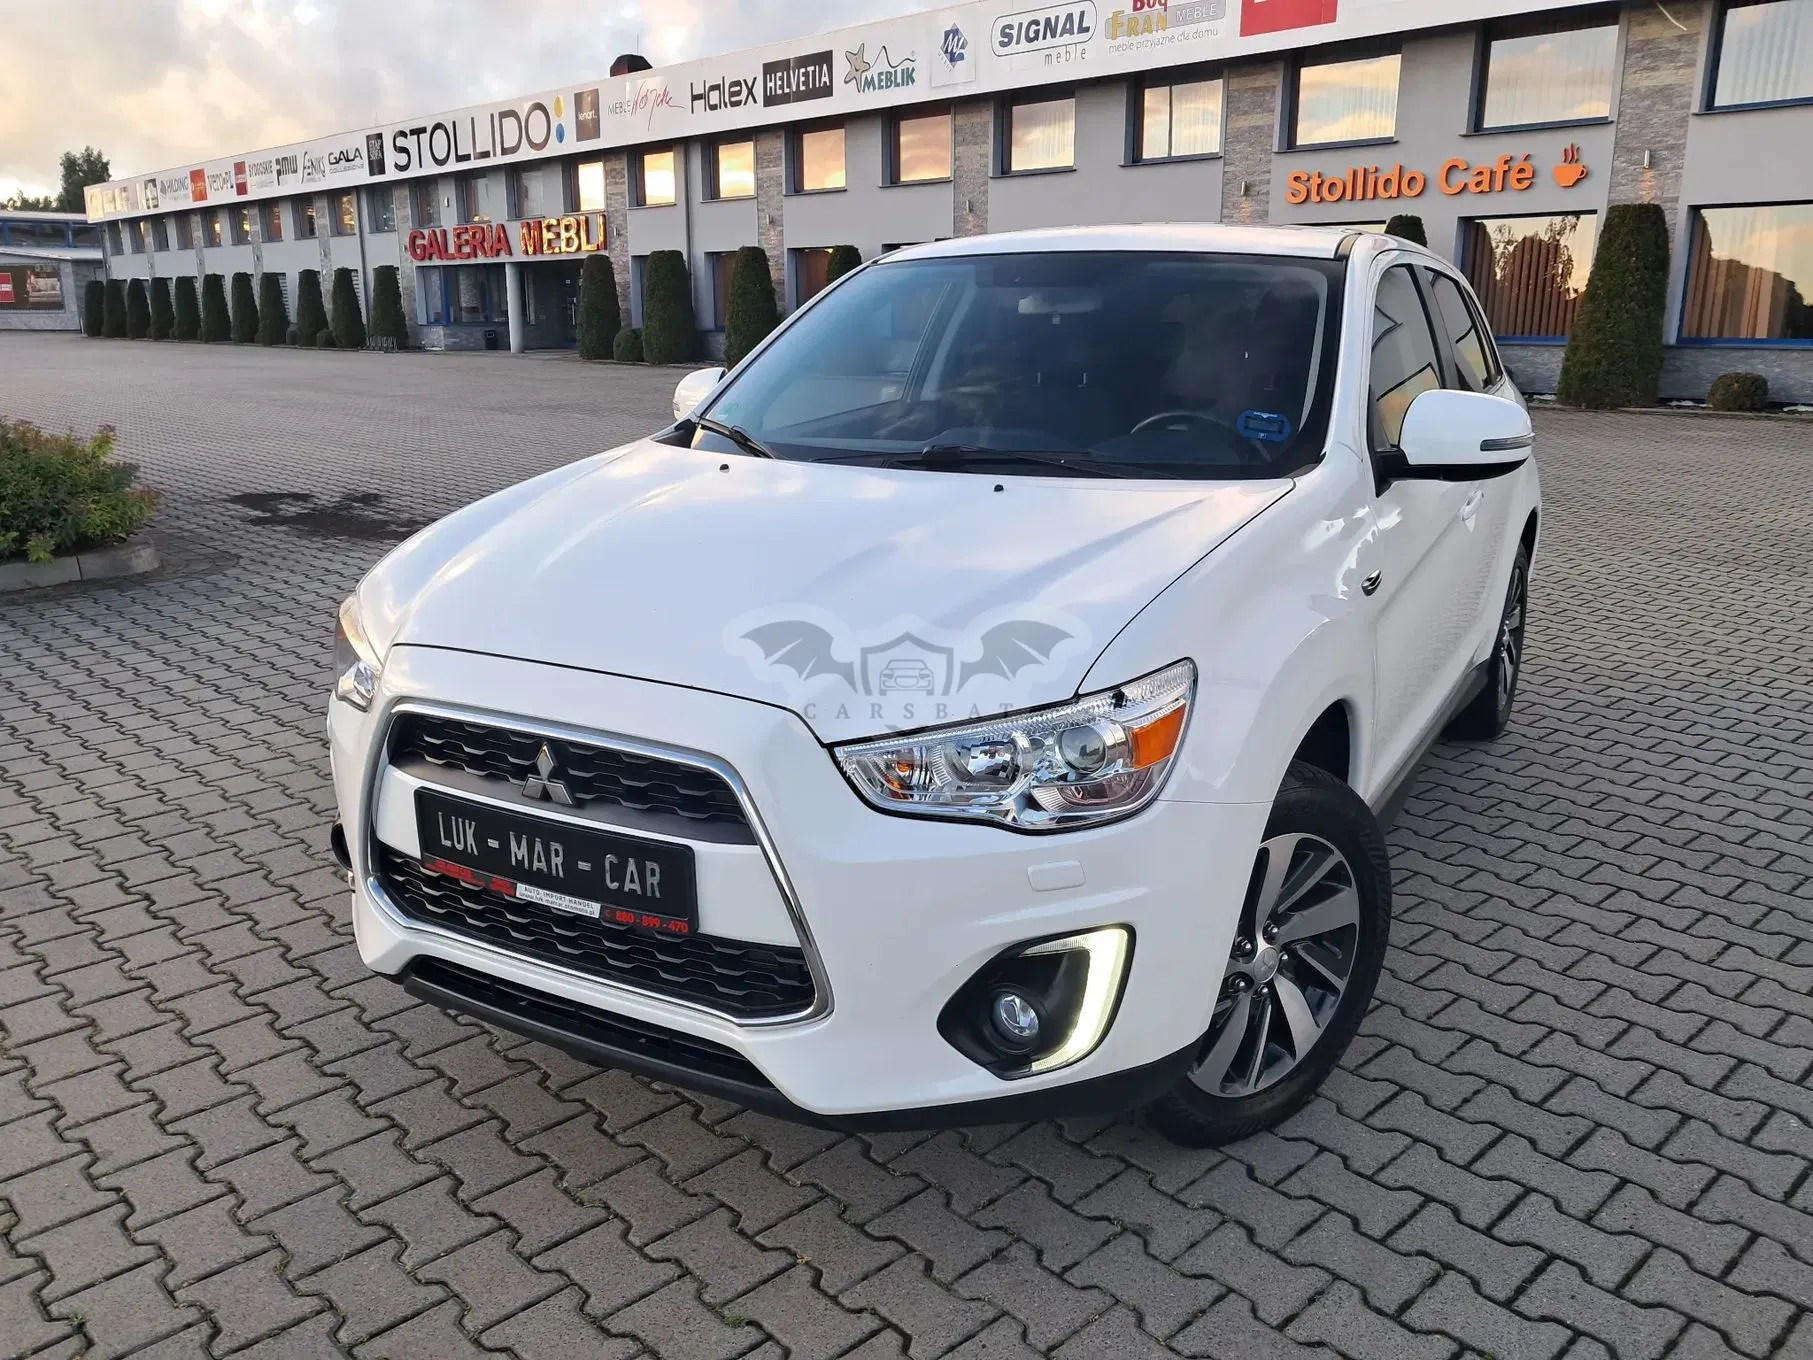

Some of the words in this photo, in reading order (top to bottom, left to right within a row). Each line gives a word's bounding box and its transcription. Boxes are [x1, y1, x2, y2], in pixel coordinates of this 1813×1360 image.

[998, 9, 1091, 48] SIGNAL
[1175, 3, 1218, 21] MEBLE
[1044, 44, 1087, 67] meble
[1108, 41, 1135, 54] meble
[1136, 34, 1176, 50] przyjazne
[1176, 30, 1190, 42] dla
[1193, 27, 1218, 40] domu
[690, 75, 758, 115] Halex
[766, 63, 831, 97] HELVETIA
[861, 66, 916, 94] MEBLIK
[607, 100, 631, 116] MEBLE
[392, 101, 551, 173] STOLLIDO
[328, 147, 363, 166] GALA
[1285, 162, 1426, 205] Stollido
[1437, 152, 1536, 196] Café
[407, 222, 513, 263] GALERIA
[519, 214, 608, 256] MEBLI
[437, 811, 479, 857] LUK
[509, 830, 565, 880] MAR
[604, 853, 661, 899] CAR
